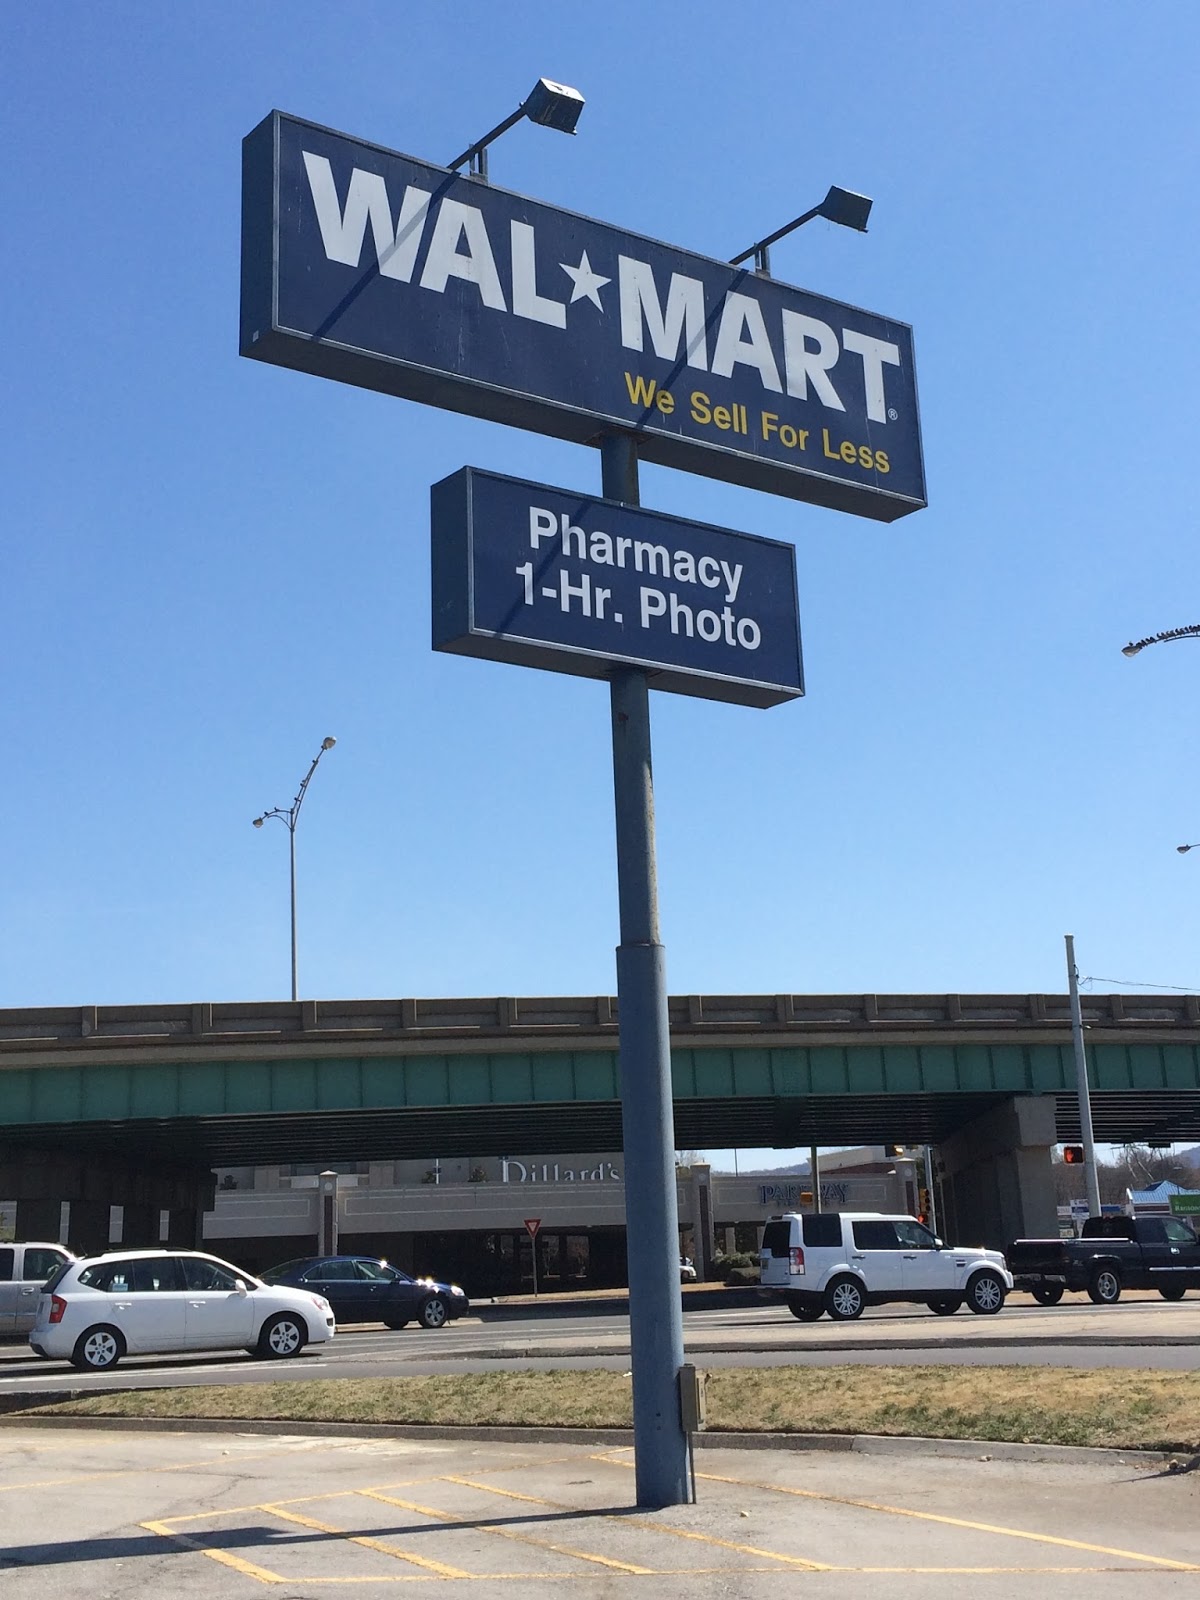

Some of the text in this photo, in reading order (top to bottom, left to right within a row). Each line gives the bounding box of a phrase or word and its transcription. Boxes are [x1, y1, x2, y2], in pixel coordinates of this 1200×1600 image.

[624, 371, 890, 473] We Sell For Less
[529, 506, 743, 603] Pharmacy
[516, 561, 761, 650] 1-Hr. Photo
[502, 1160, 620, 1183] Dillard's
